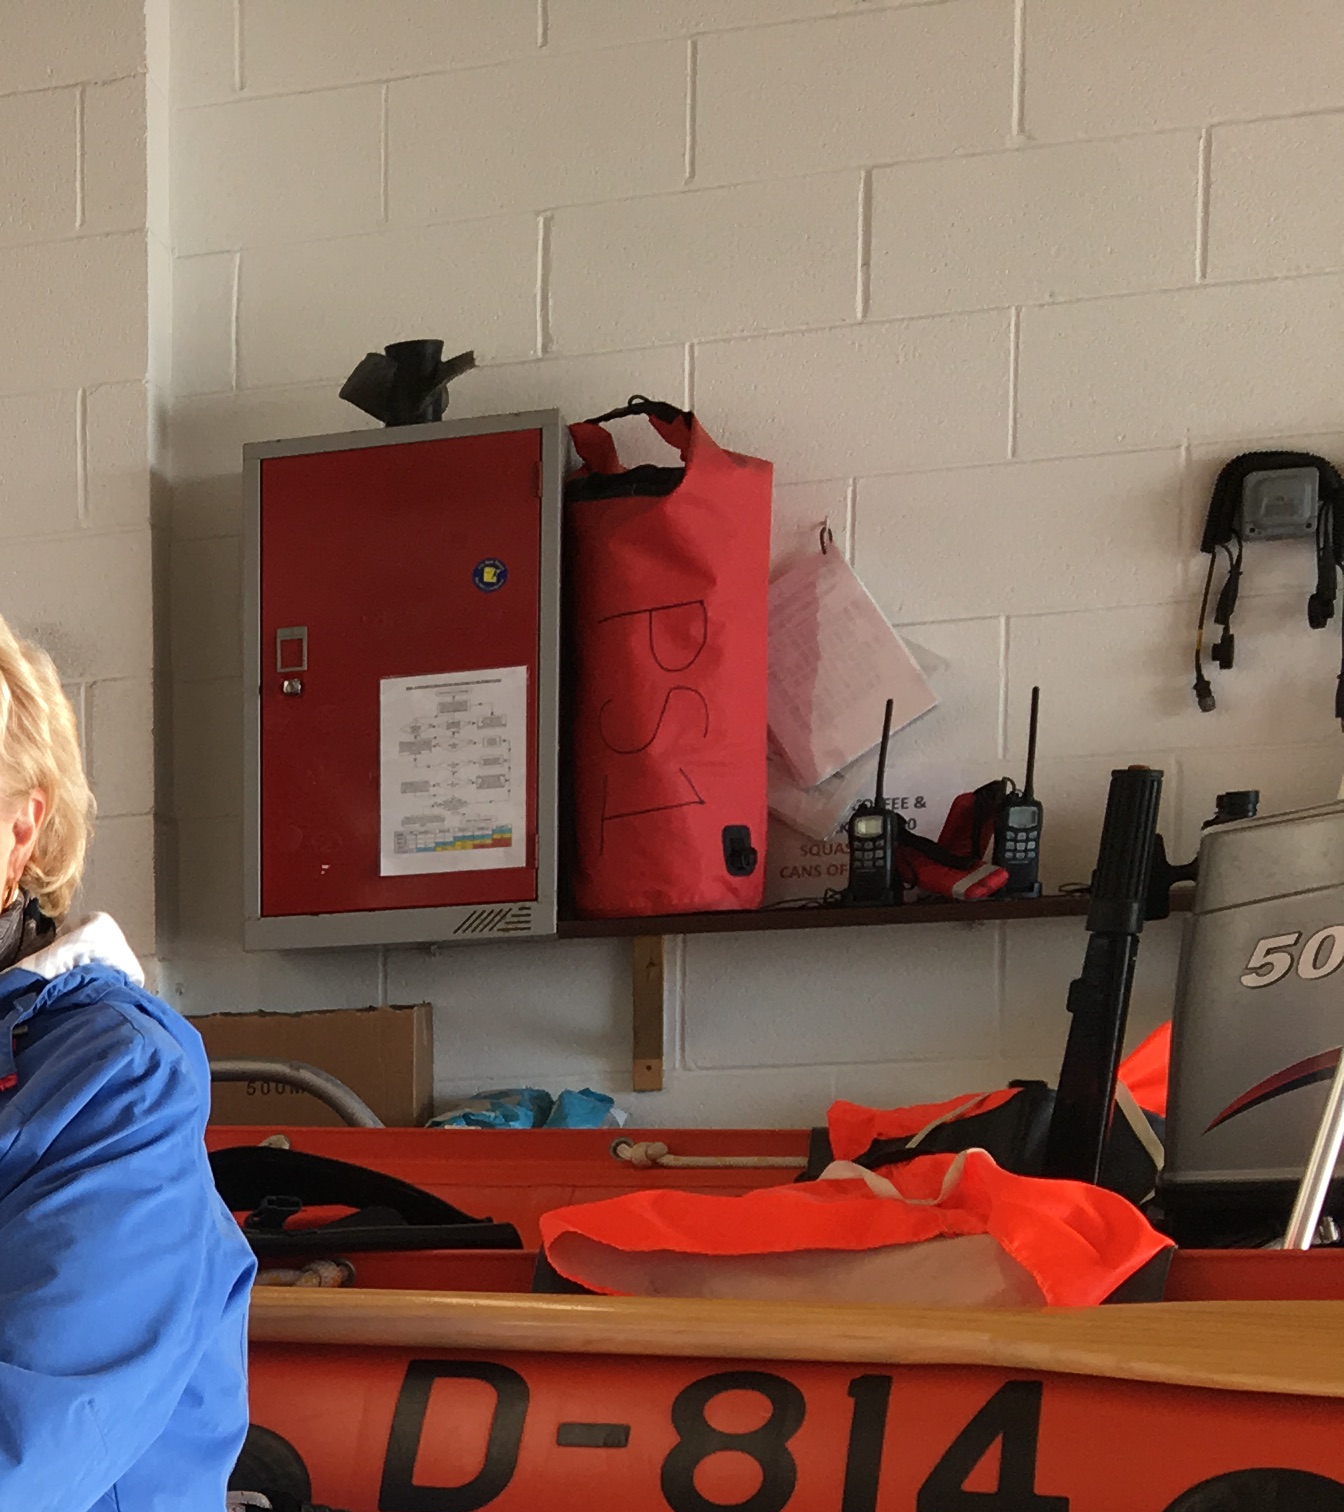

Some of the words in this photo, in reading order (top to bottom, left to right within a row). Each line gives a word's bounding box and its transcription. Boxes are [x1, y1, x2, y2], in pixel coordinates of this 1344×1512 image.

[913, 795, 927, 809] &
[779, 865, 823, 879] CANS
[826, 863, 849, 876] OF
[1240, 923, 1344, 990] 50
